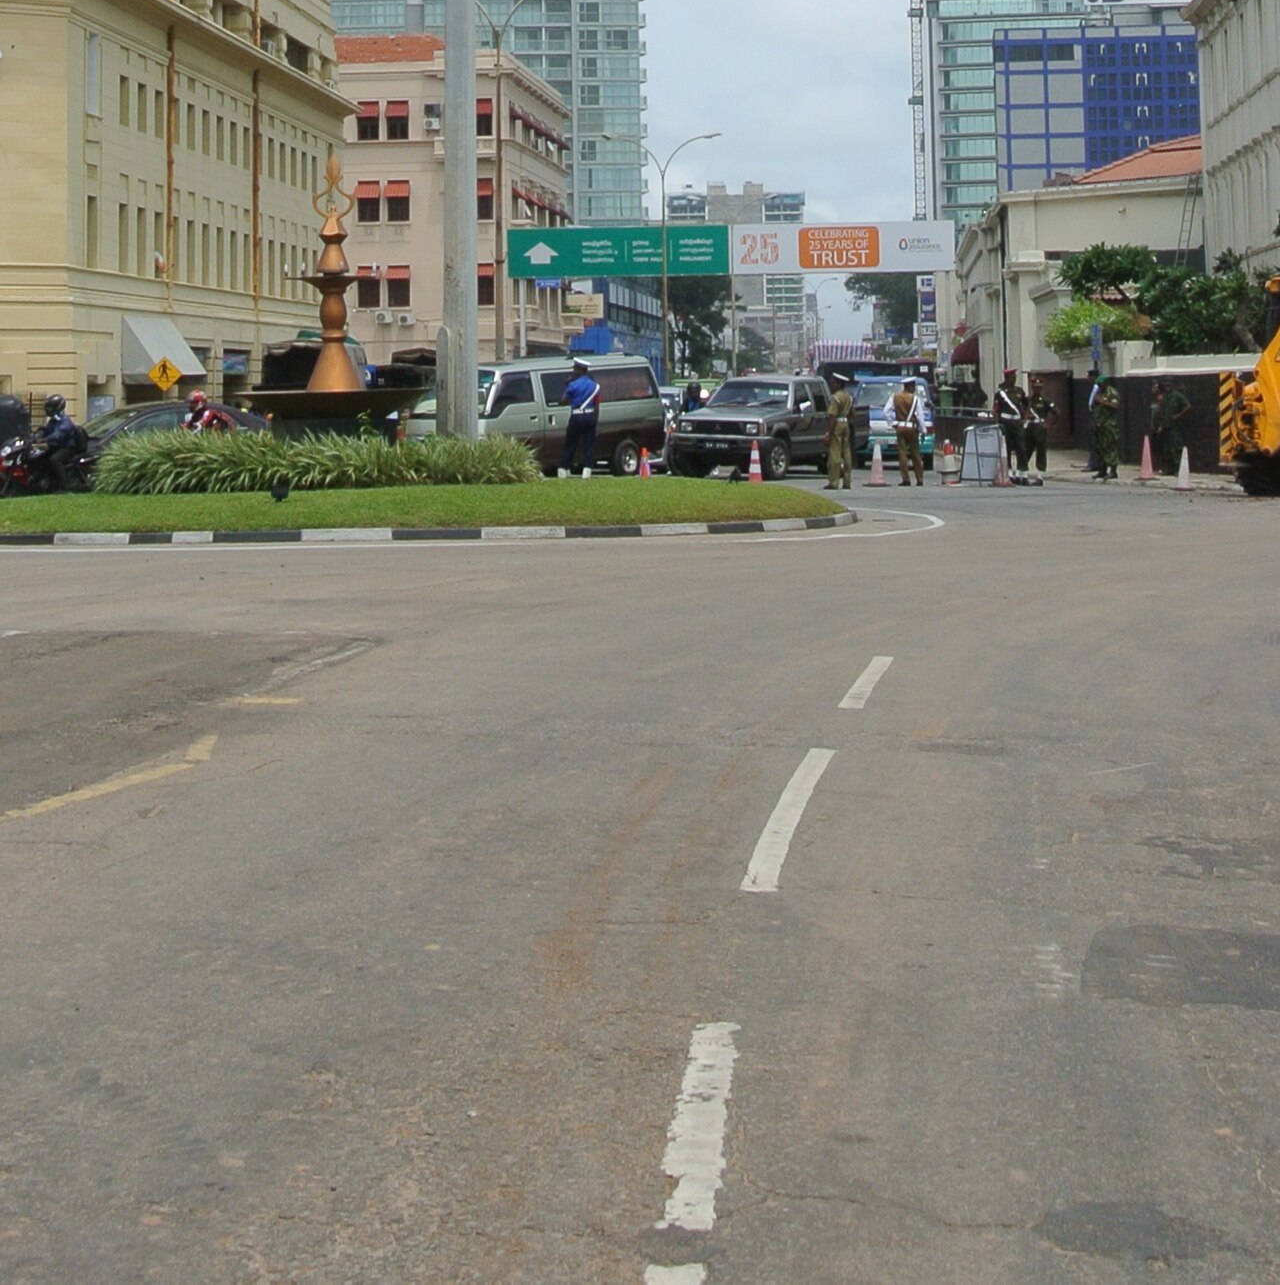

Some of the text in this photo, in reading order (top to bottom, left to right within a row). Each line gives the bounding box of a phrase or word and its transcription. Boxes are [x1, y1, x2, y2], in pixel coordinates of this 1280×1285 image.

[808, 229, 869, 239] CELEBRATING
[740, 233, 779, 265] 25
[808, 240, 869, 250] 25 YEARS OF
[810, 250, 869, 266] TRUST
